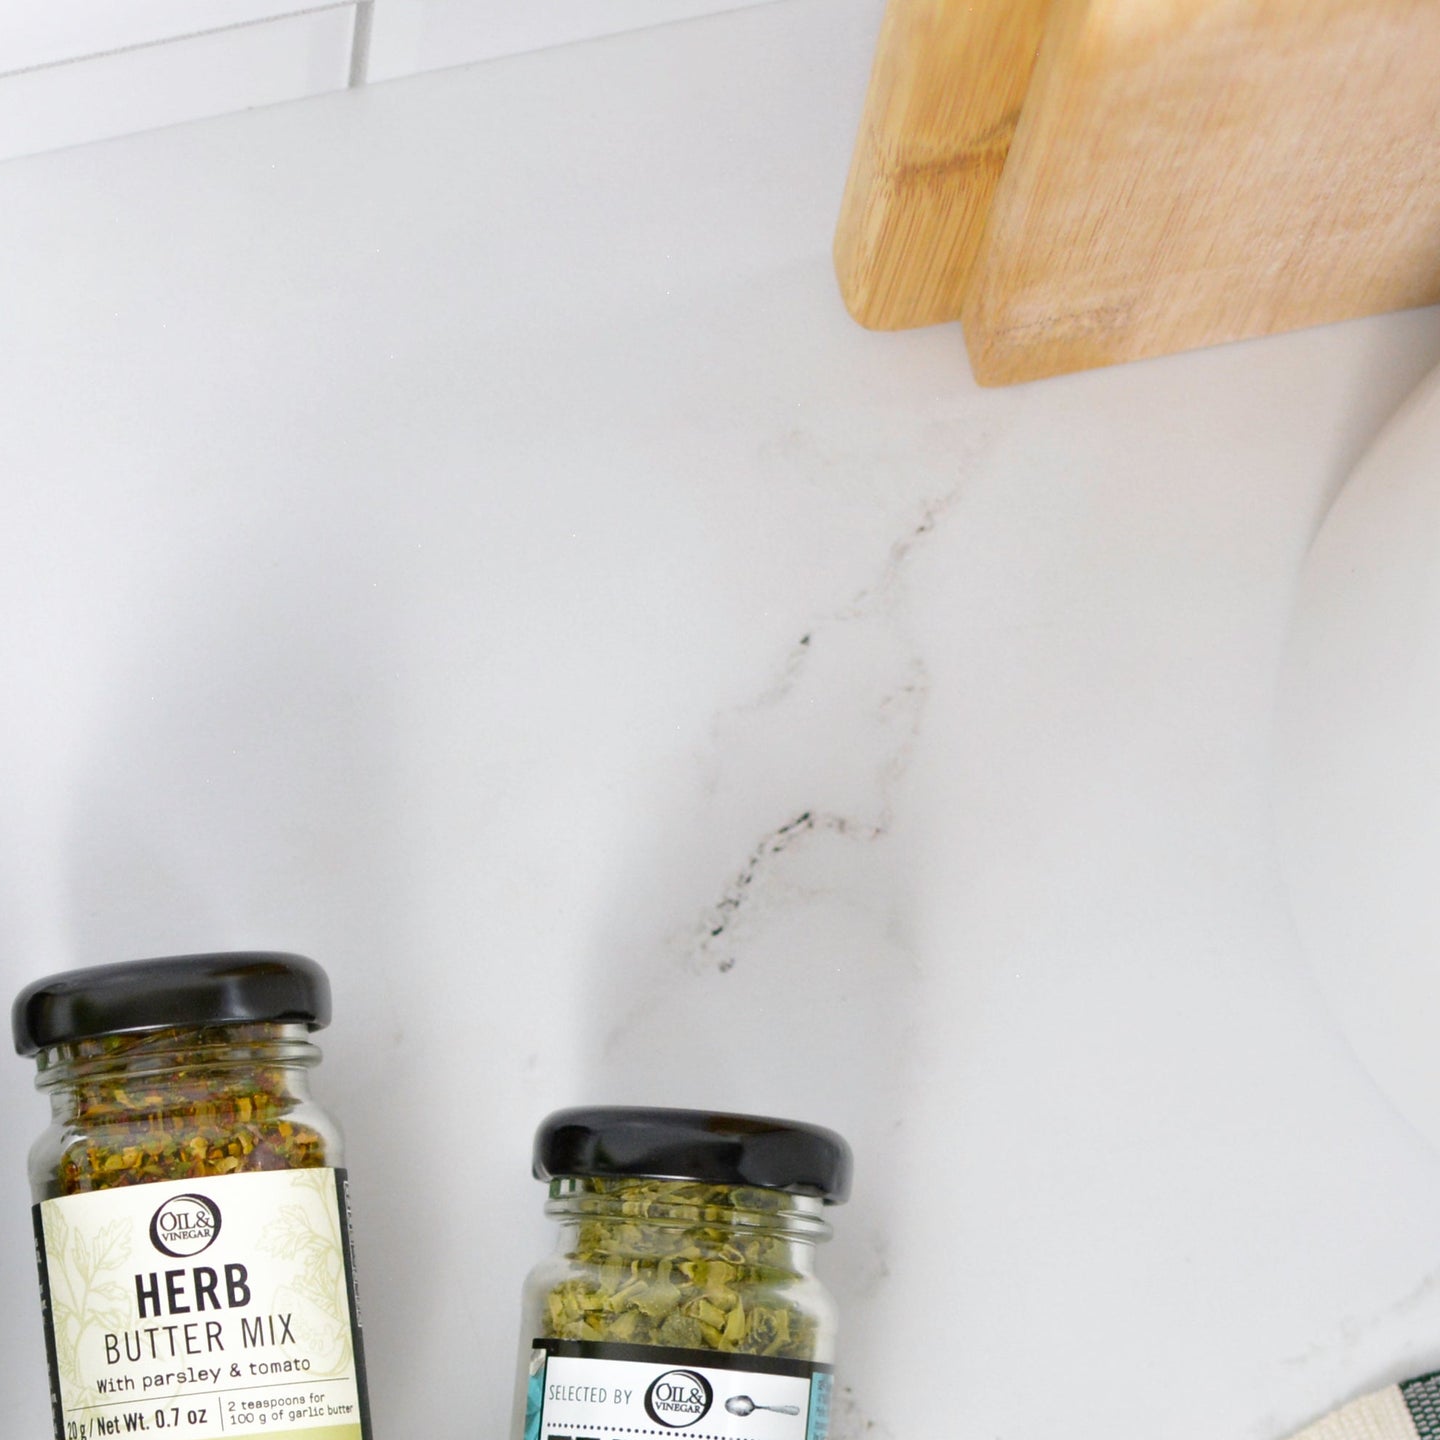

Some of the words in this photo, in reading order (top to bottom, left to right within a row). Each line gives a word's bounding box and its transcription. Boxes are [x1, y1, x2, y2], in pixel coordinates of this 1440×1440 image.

[159, 1211, 215, 1232] OIL&
[161, 1228, 212, 1242] VINEGAR
[134, 1263, 252, 1319] HERB
[104, 1320, 226, 1365] BUTTER
[241, 1312, 297, 1348] MIX
[96, 1374, 135, 1394] With
[143, 1366, 221, 1392] parsley
[229, 1363, 242, 1377] &
[250, 1358, 311, 1375] tomato
[228, 1402, 236, 1411] 2
[241, 1396, 305, 1411] teaspoons
[309, 1393, 325, 1404] for
[548, 1384, 608, 1405] SELECTED
[613, 1389, 633, 1405] BY
[656, 1382, 705, 1407] OIL&
[231, 1413, 254, 1424] 100
[259, 1411, 266, 1424] g
[272, 1409, 284, 1420] of
[288, 1406, 324, 1421] garlic
[327, 1404, 354, 1416] butter
[654, 1401, 701, 1415] VINEGAR
[67, 1422, 78, 1440] 20
[97, 1418, 120, 1436] Net
[123, 1413, 150, 1432] Wt.
[155, 1408, 180, 1429] 0.7
[187, 1409, 207, 1424] oz
